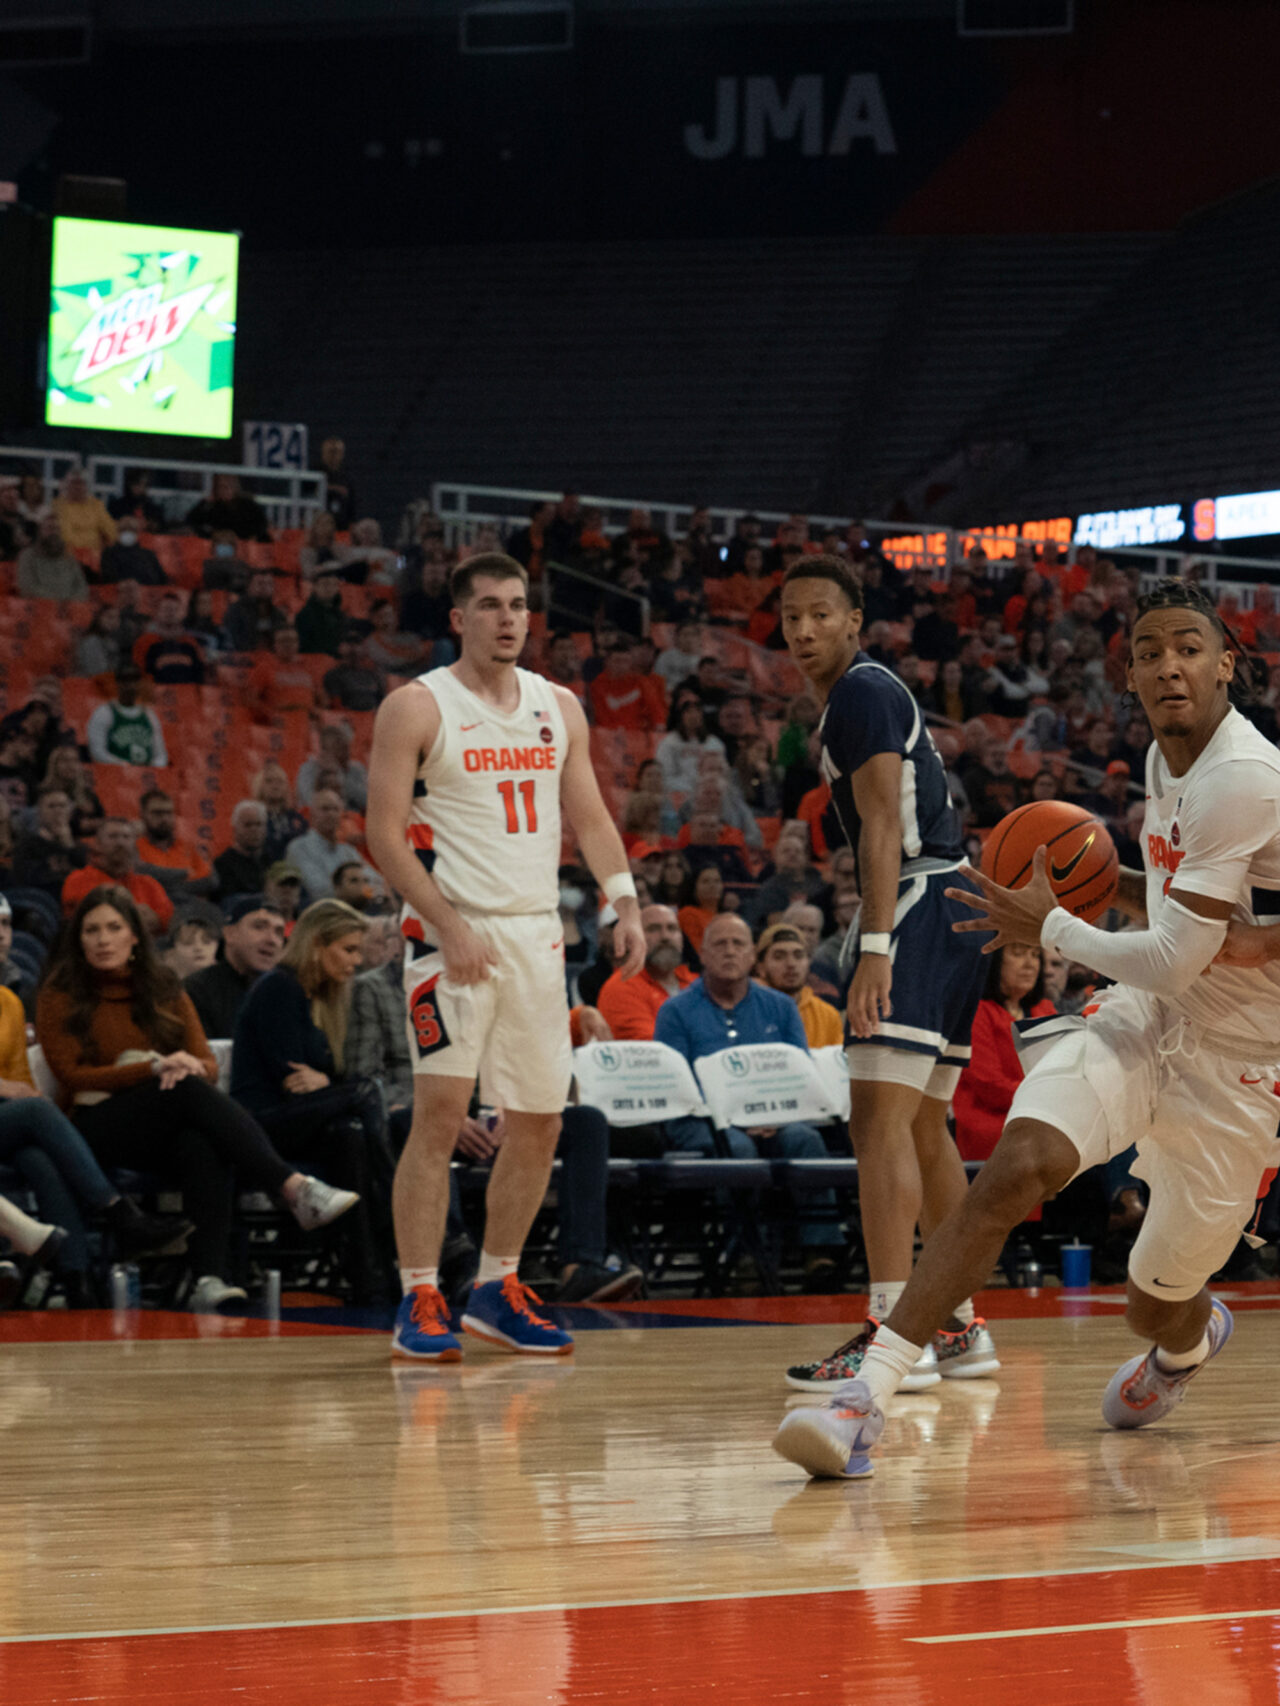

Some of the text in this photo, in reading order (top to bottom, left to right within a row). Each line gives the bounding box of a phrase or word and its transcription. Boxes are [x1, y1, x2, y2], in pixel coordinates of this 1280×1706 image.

[684, 73, 898, 160] JMA
[250, 426, 302, 471] 124
[463, 746, 557, 773] ORANGE
[497, 779, 538, 834] 11
[411, 1002, 442, 1047] S
